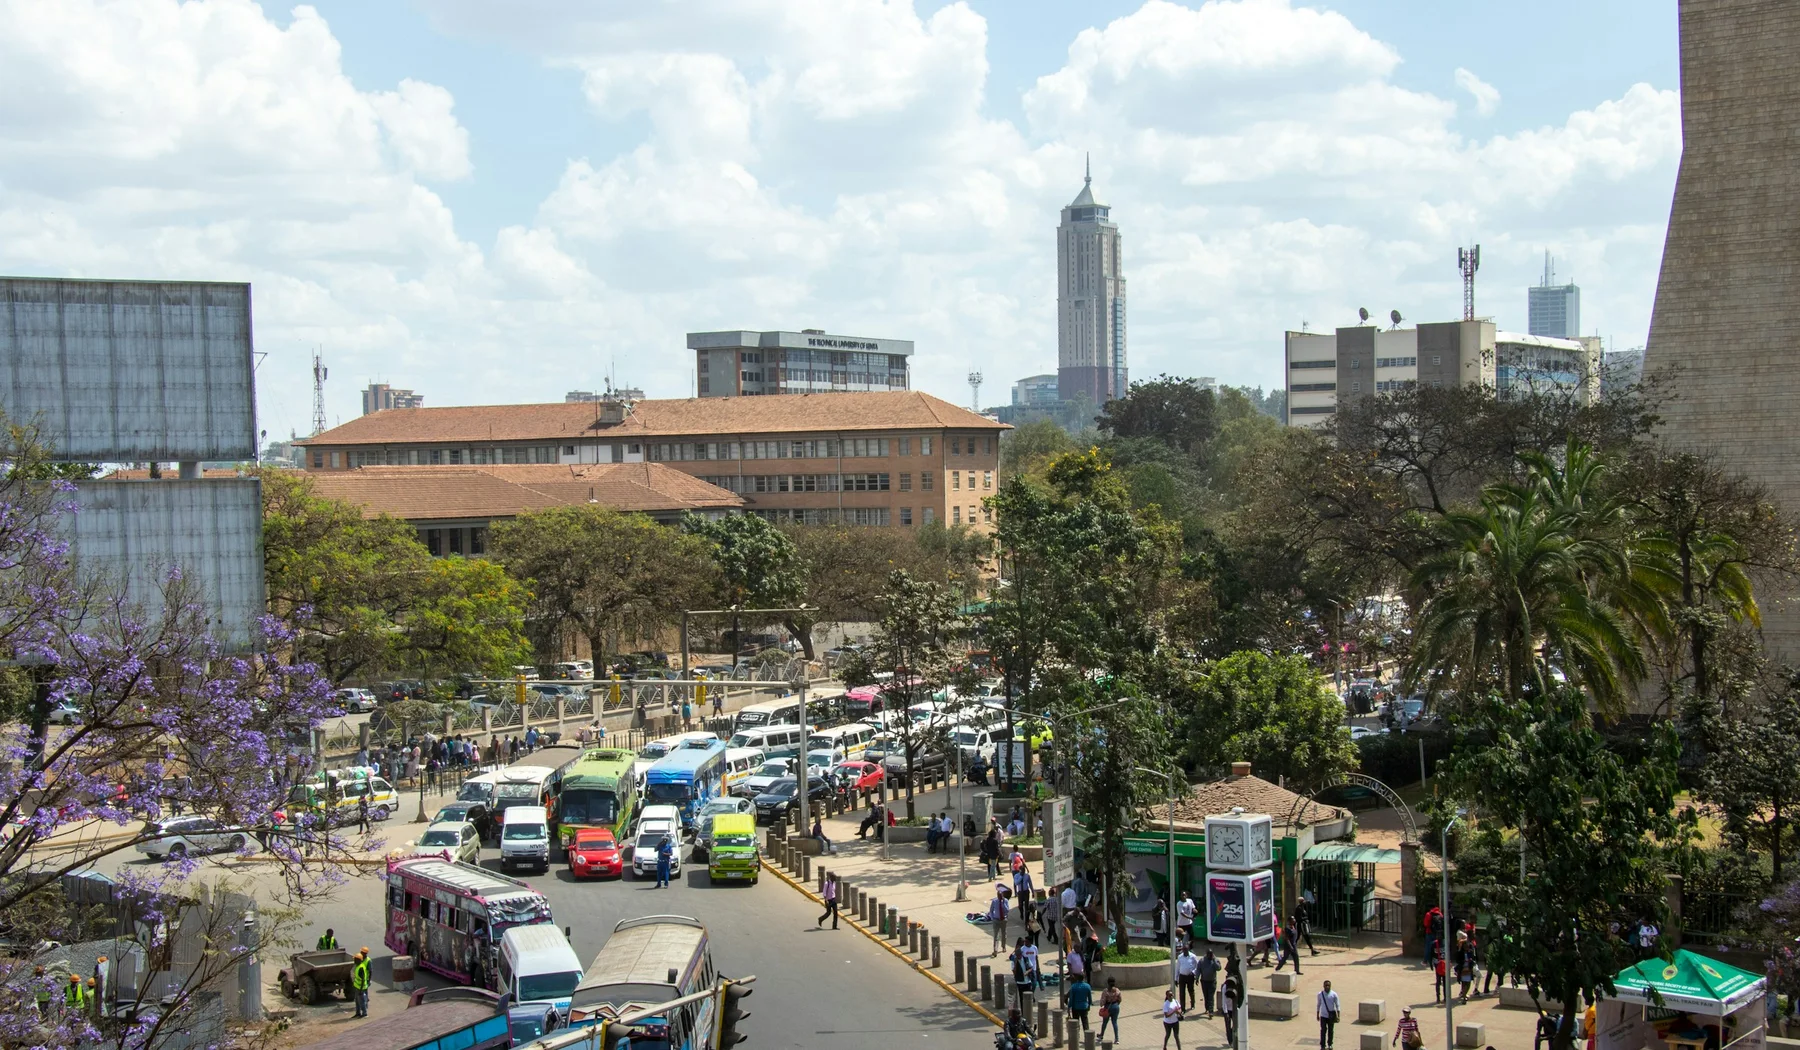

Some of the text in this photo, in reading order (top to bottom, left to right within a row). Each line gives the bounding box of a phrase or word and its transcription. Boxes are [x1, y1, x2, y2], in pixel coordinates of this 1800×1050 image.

[808, 338, 816, 346] THE
[816, 339, 838, 348] TECHNICAL
[838, 340, 860, 350] UNIVERSITY
[866, 342, 878, 351] KENYA
[1223, 904, 1244, 914] 254
[1259, 899, 1271, 912] 254
